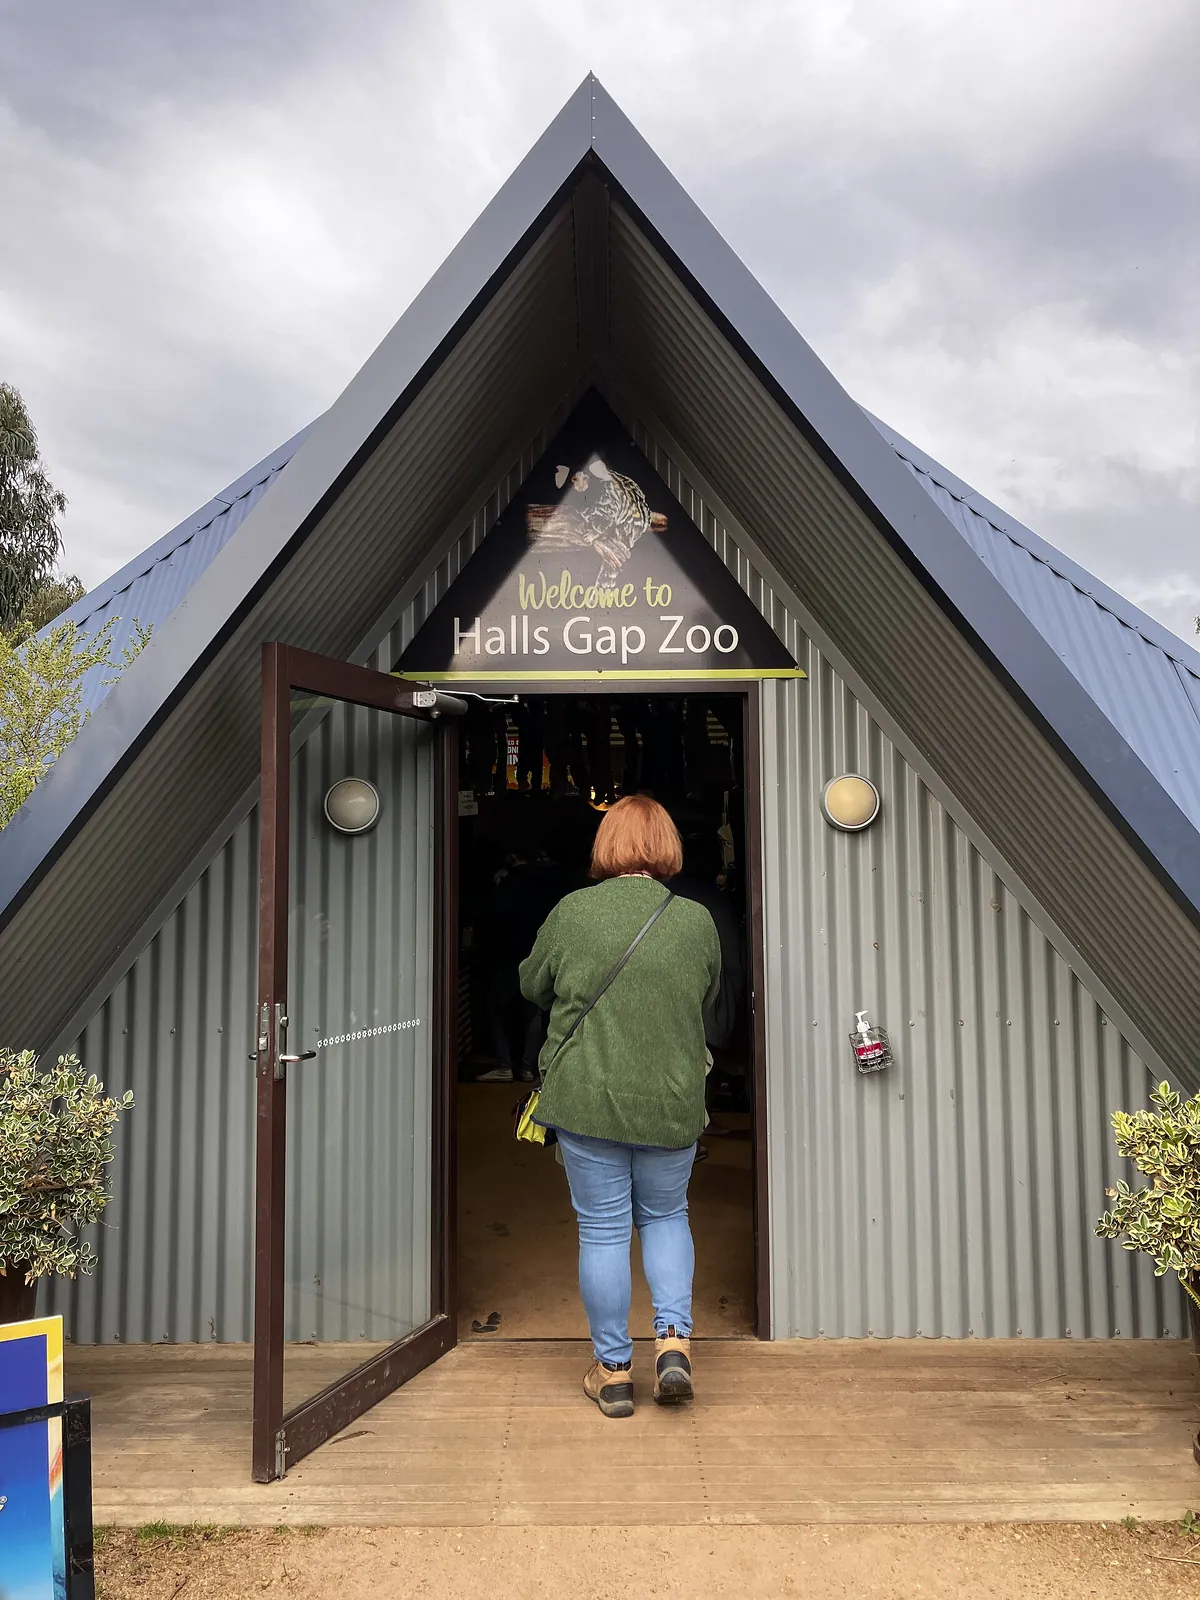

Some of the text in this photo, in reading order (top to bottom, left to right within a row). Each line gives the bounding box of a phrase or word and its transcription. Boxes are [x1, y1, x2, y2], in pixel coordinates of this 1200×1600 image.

[519, 570, 673, 611] Welcome to
[453, 615, 739, 664] Halls Gap Zoo
